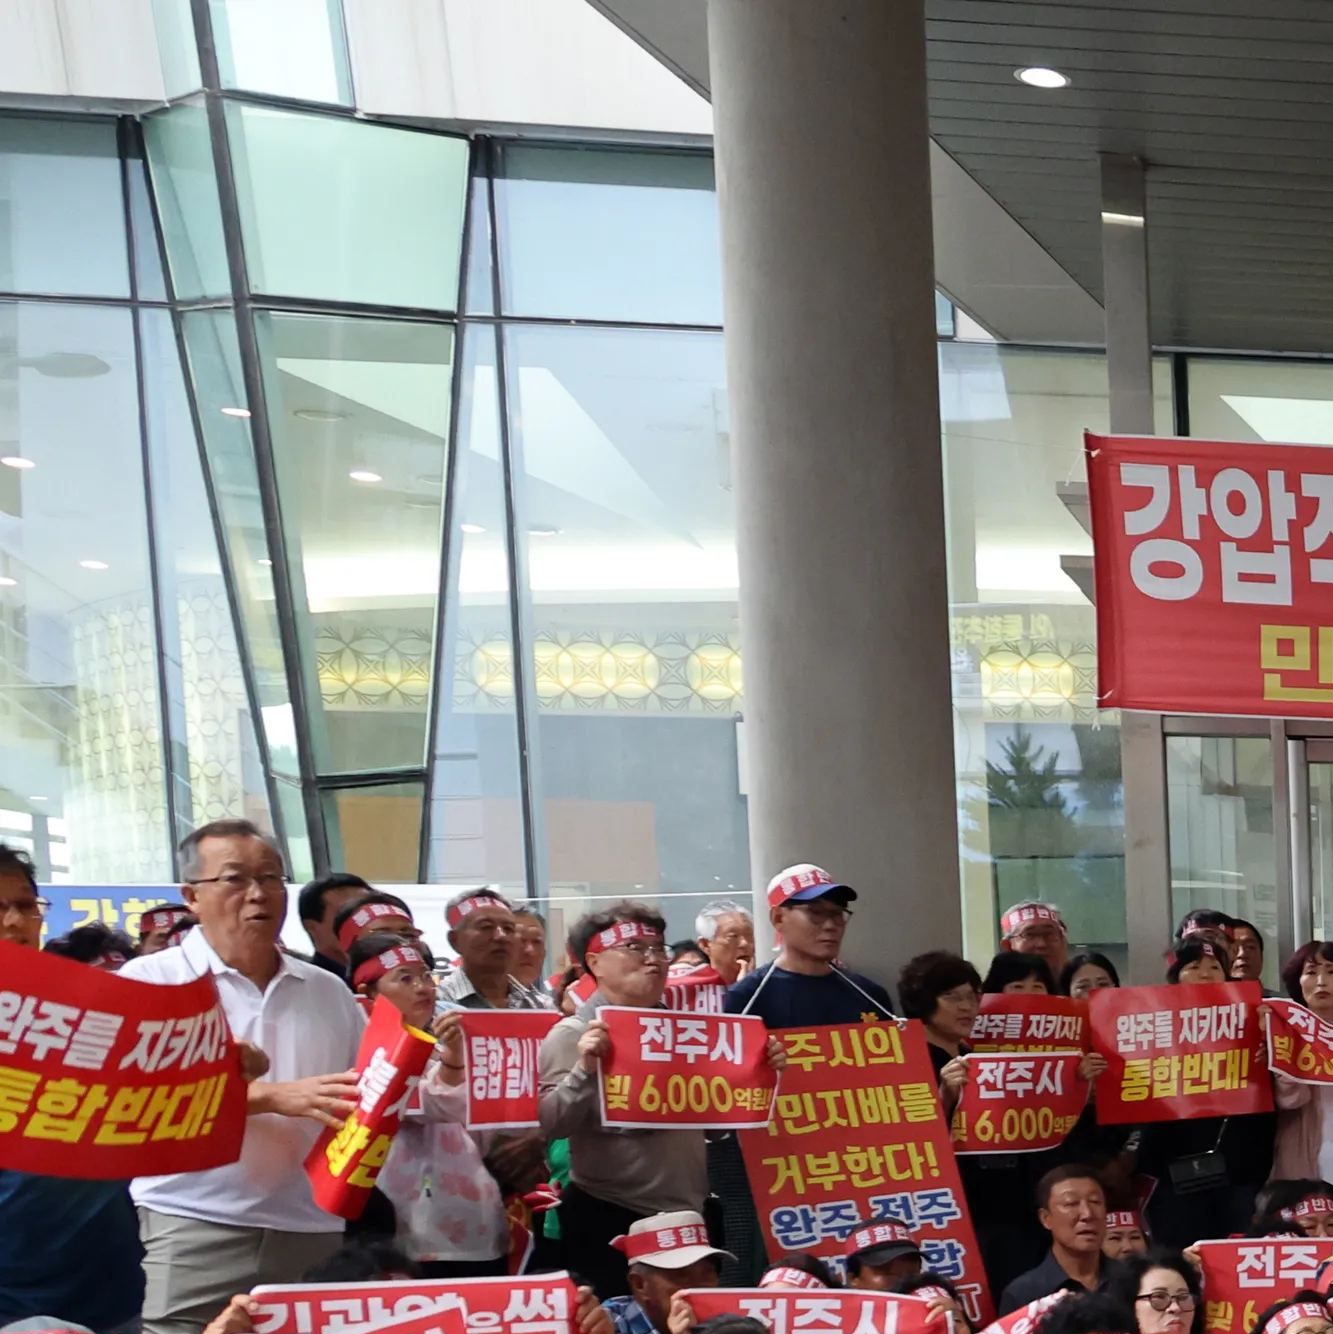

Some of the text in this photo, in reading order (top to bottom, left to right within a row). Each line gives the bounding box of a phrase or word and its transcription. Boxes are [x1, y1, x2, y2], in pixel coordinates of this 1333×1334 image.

[119, 1007, 227, 1074] 지키자!
[639, 1017, 743, 1064] 전주시
[784, 1026, 905, 1072] 주시의
[971, 1014, 1082, 1039] 완주를 지키자!
[1117, 1002, 1246, 1052] 완주를 지키자!
[1273, 1036, 1294, 1061] 빚
[605, 1076, 772, 1115] 빚 6,000억원!
[976, 1061, 1063, 1099] 전주시
[1121, 1048, 1250, 1102] 통합반대!
[766, 1082, 939, 1136] 민지배를
[974, 1107, 1079, 1142] 6,000억원
[762, 1142, 940, 1195] 거부한다!
[771, 1199, 861, 1251] 완주
[1237, 1246, 1318, 1288] 전주
